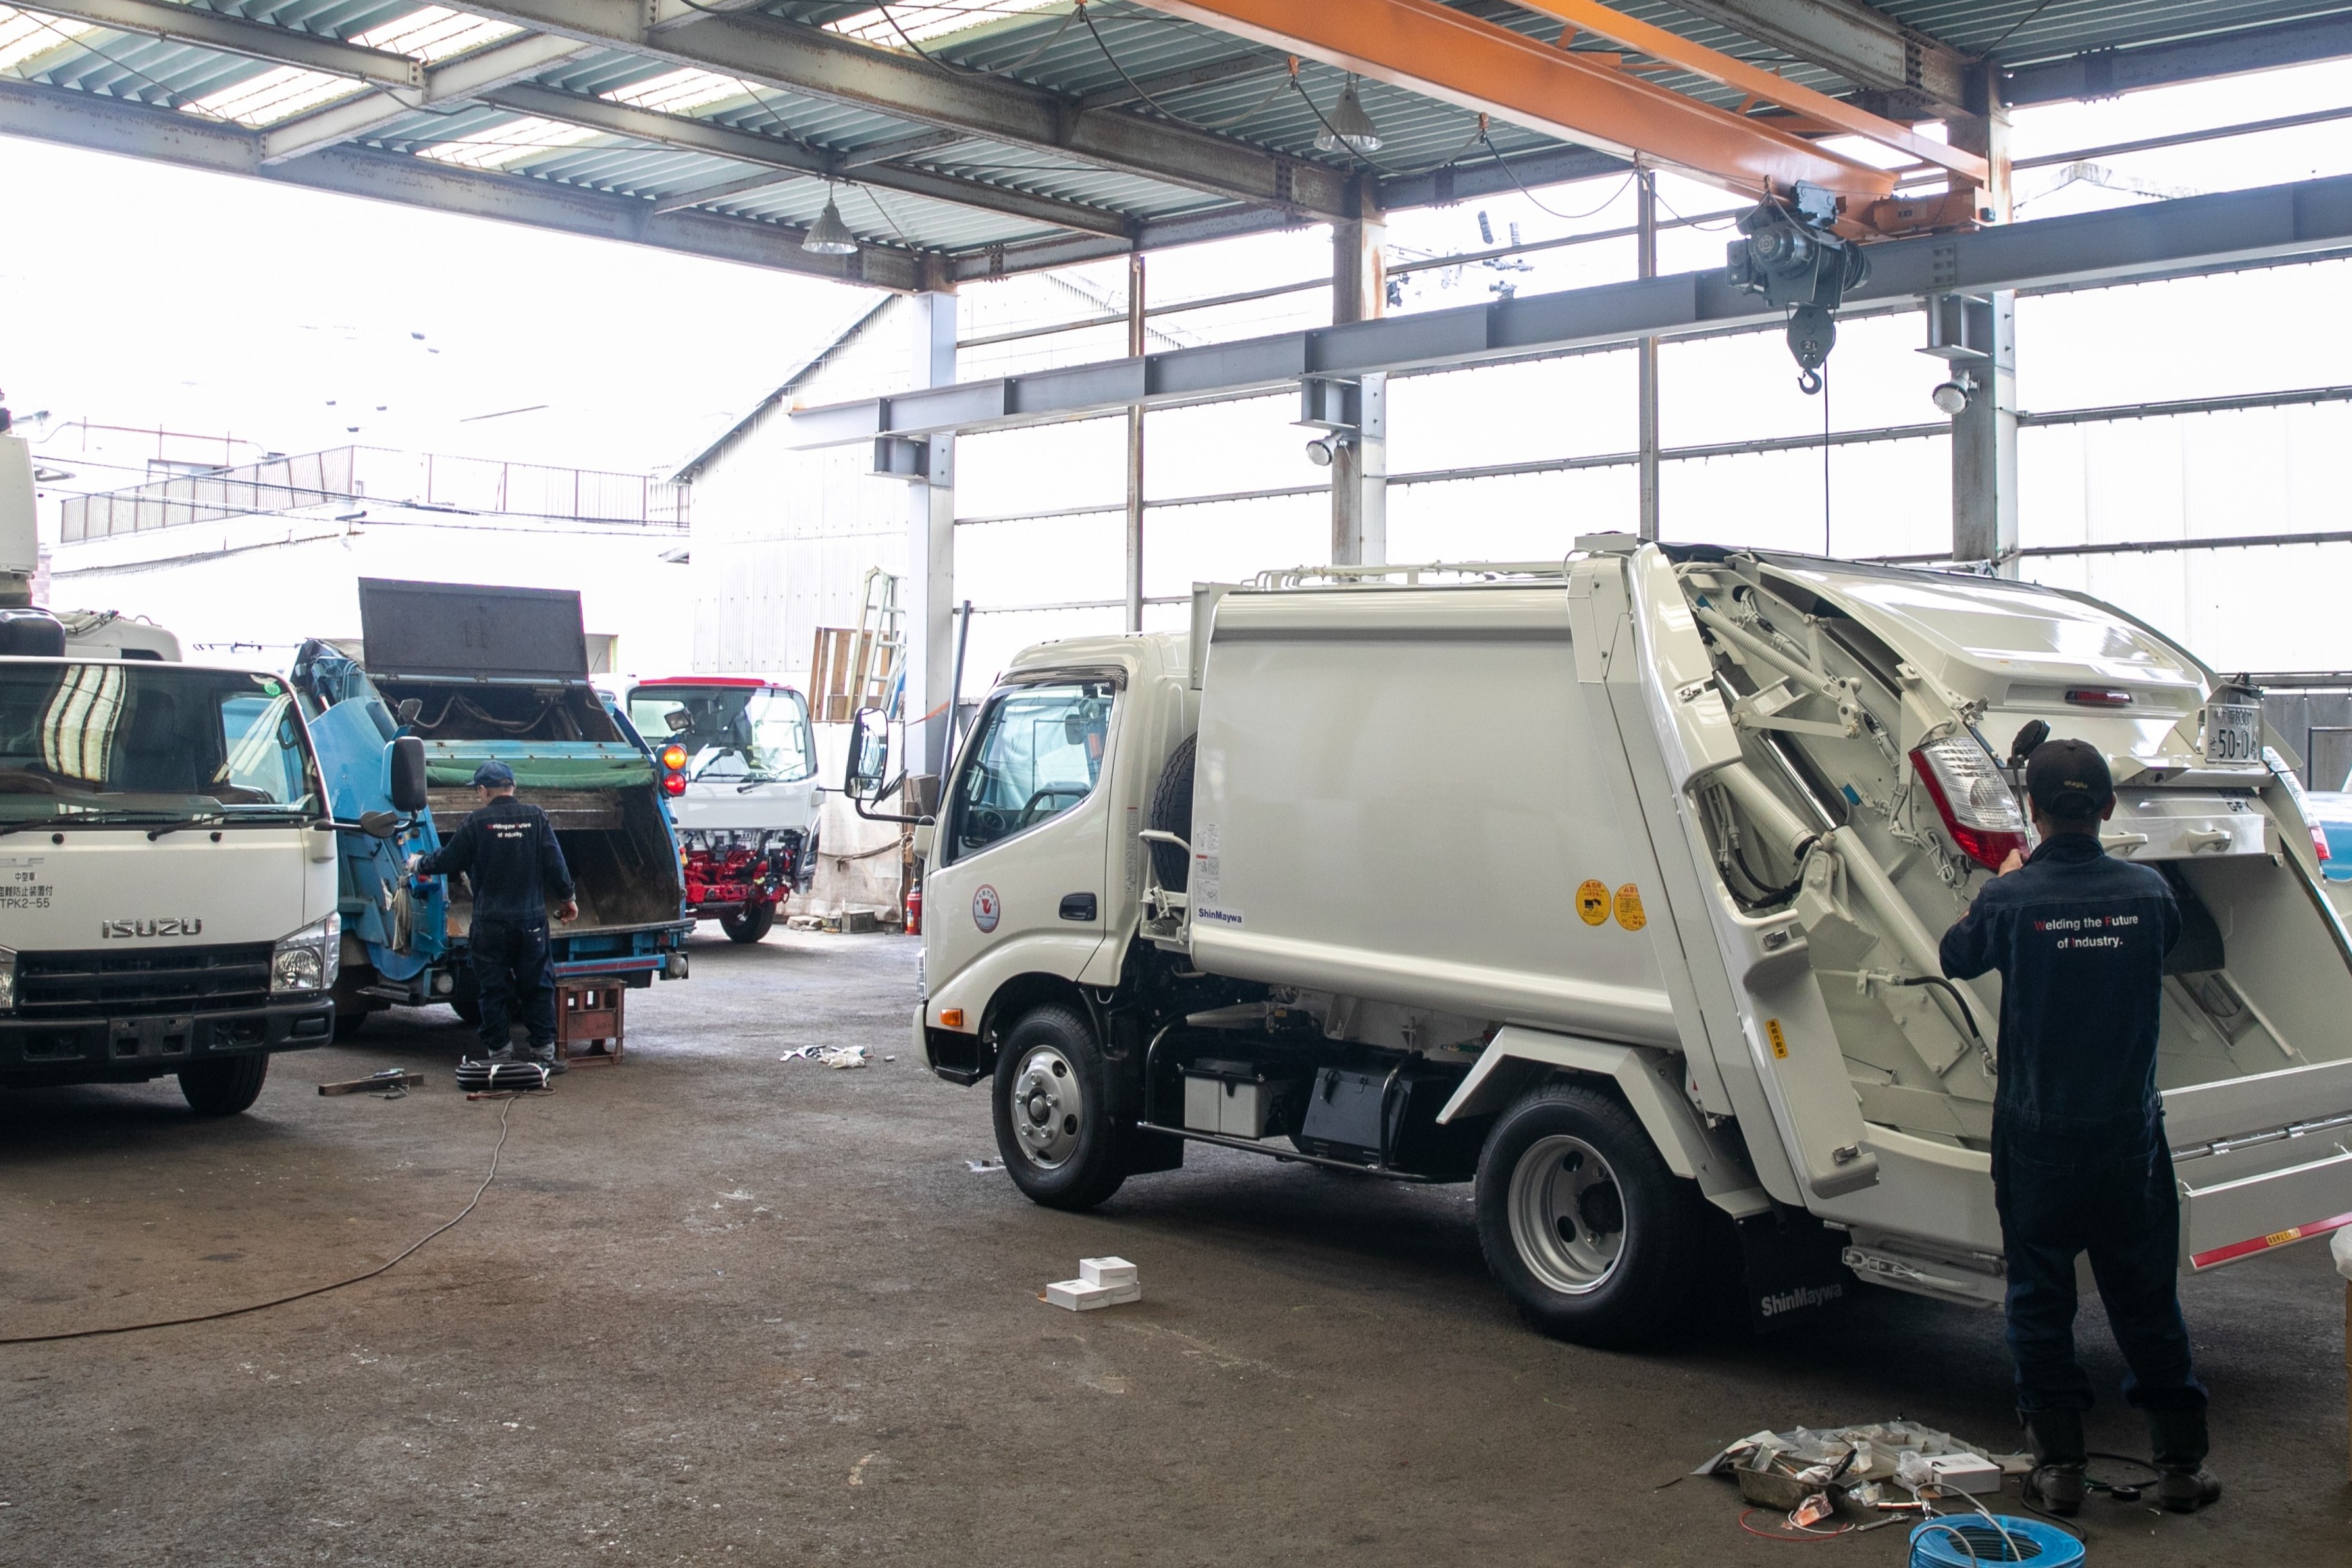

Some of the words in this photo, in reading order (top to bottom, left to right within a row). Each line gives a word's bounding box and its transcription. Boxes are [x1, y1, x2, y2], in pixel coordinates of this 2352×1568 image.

[0, 898, 50, 908] TPK2-55
[1199, 908, 1242, 923] ShinMaywa
[2035, 919, 2080, 931] Welding
[2083, 917, 2102, 928] the
[2105, 915, 2138, 926] Future
[102, 917, 202, 939] ISUZU
[2057, 937, 2069, 949] of
[1762, 1283, 1843, 1316] ShinMaywa
